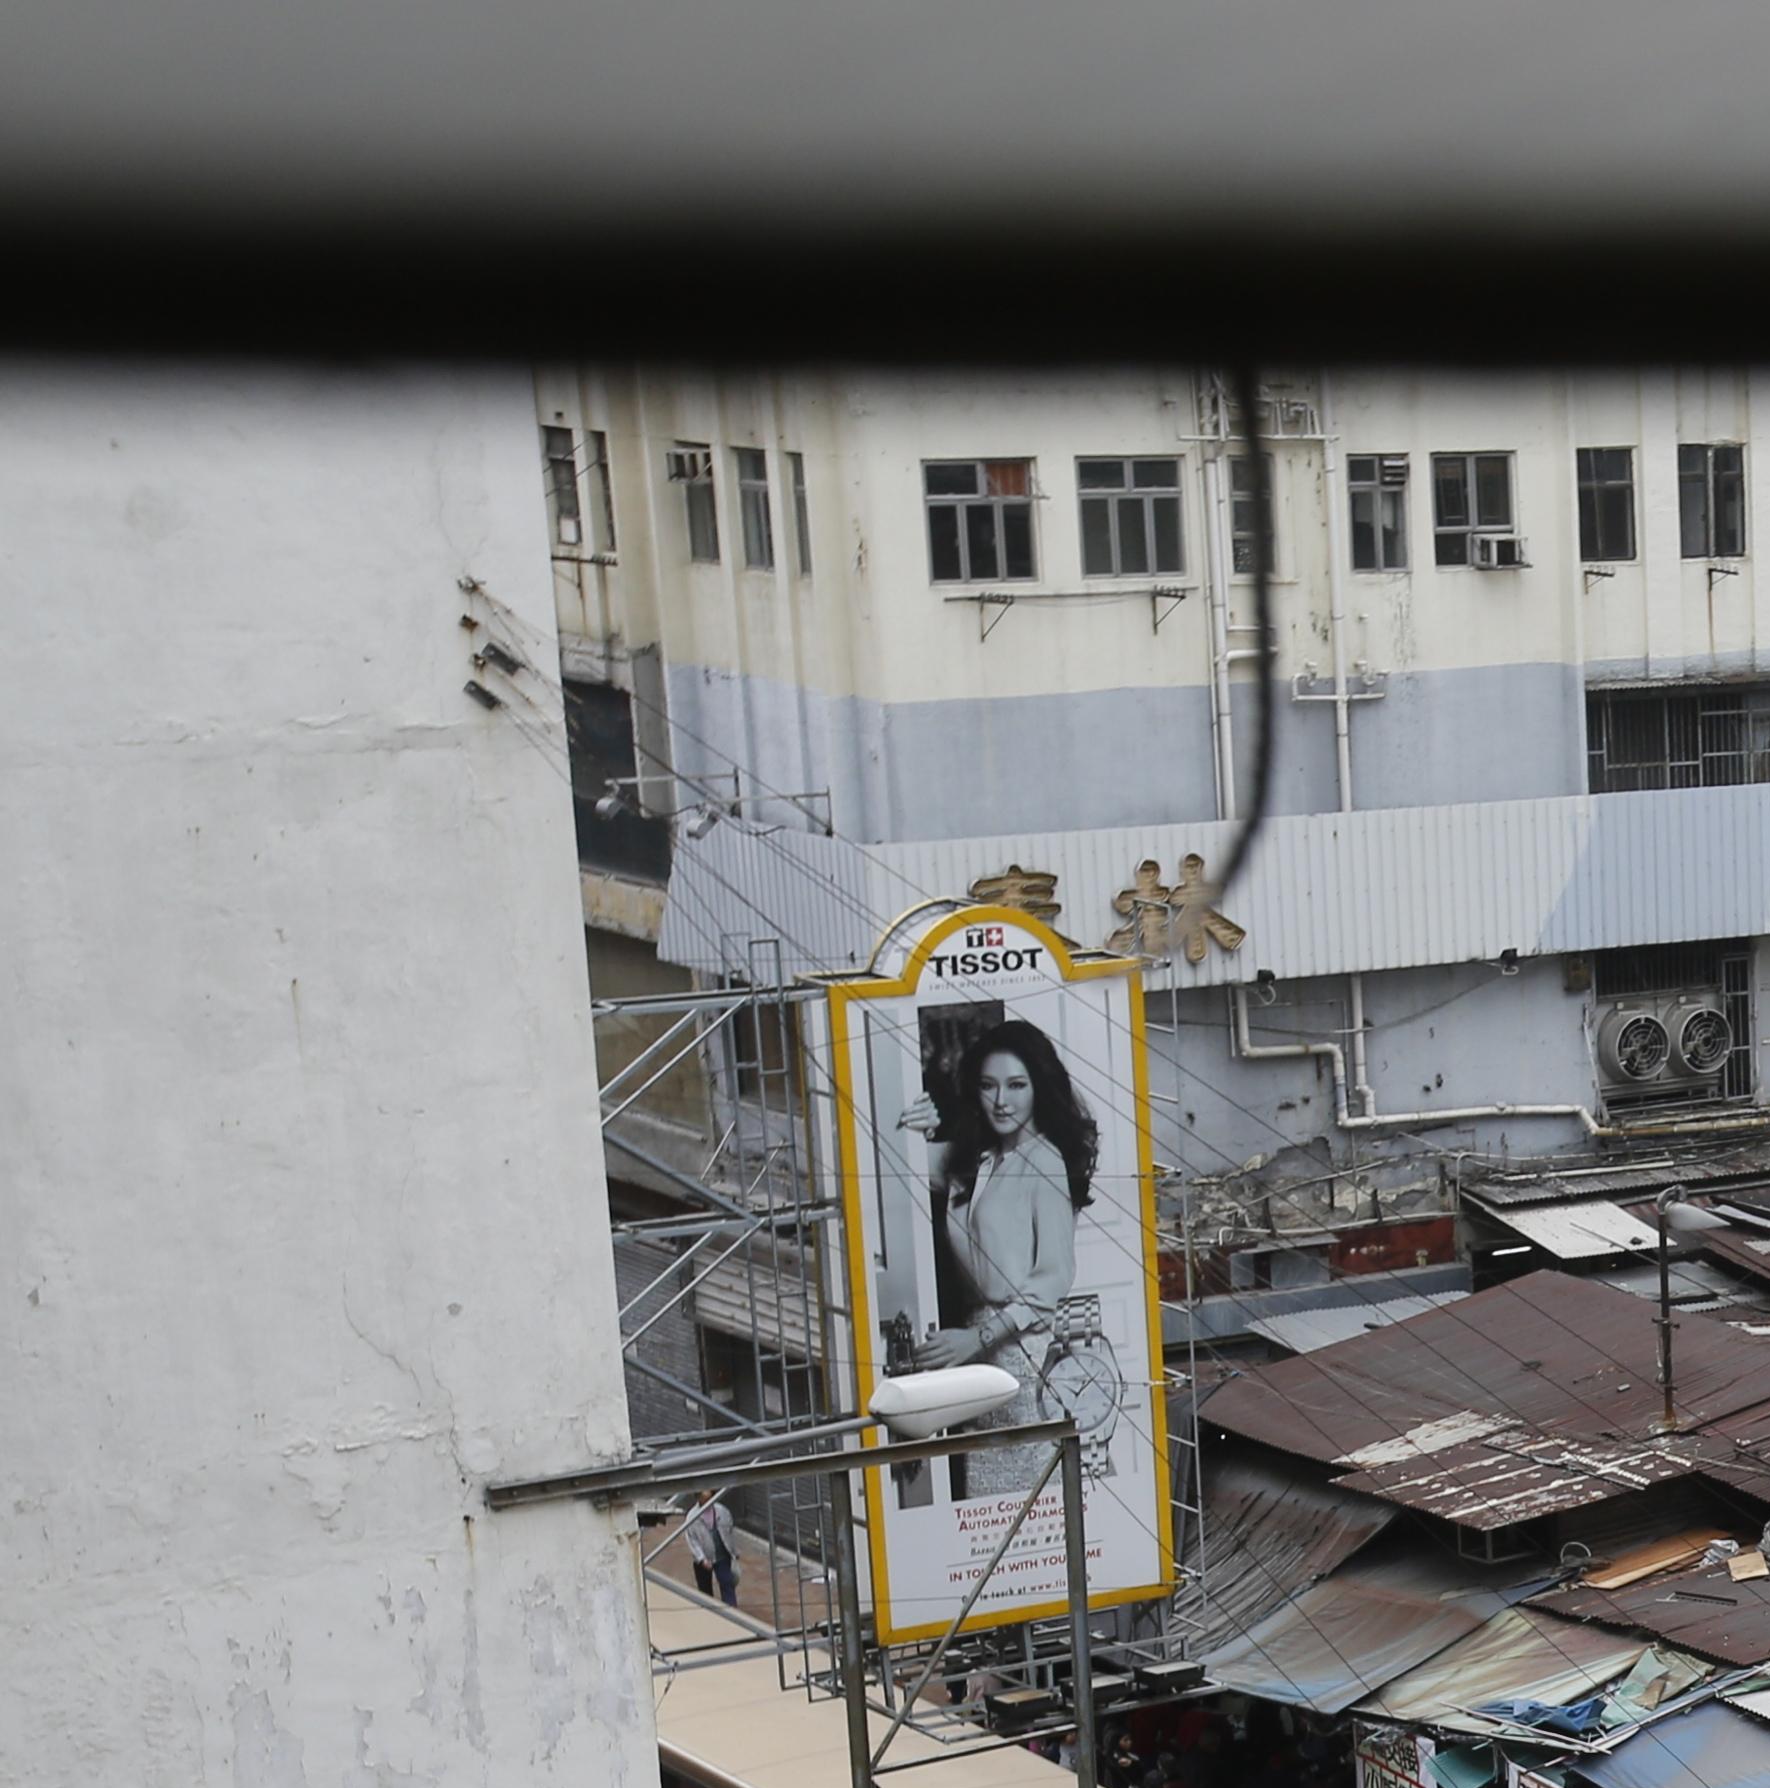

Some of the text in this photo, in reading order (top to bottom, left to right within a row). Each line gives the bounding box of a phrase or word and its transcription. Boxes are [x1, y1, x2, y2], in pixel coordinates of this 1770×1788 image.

[928, 948, 1043, 977] TISSOT
[949, 1572, 962, 1582] IN
[966, 1563, 1005, 1581] TOCH
[1008, 1556, 1038, 1572] WITH
[1041, 1552, 1067, 1567] YOU
